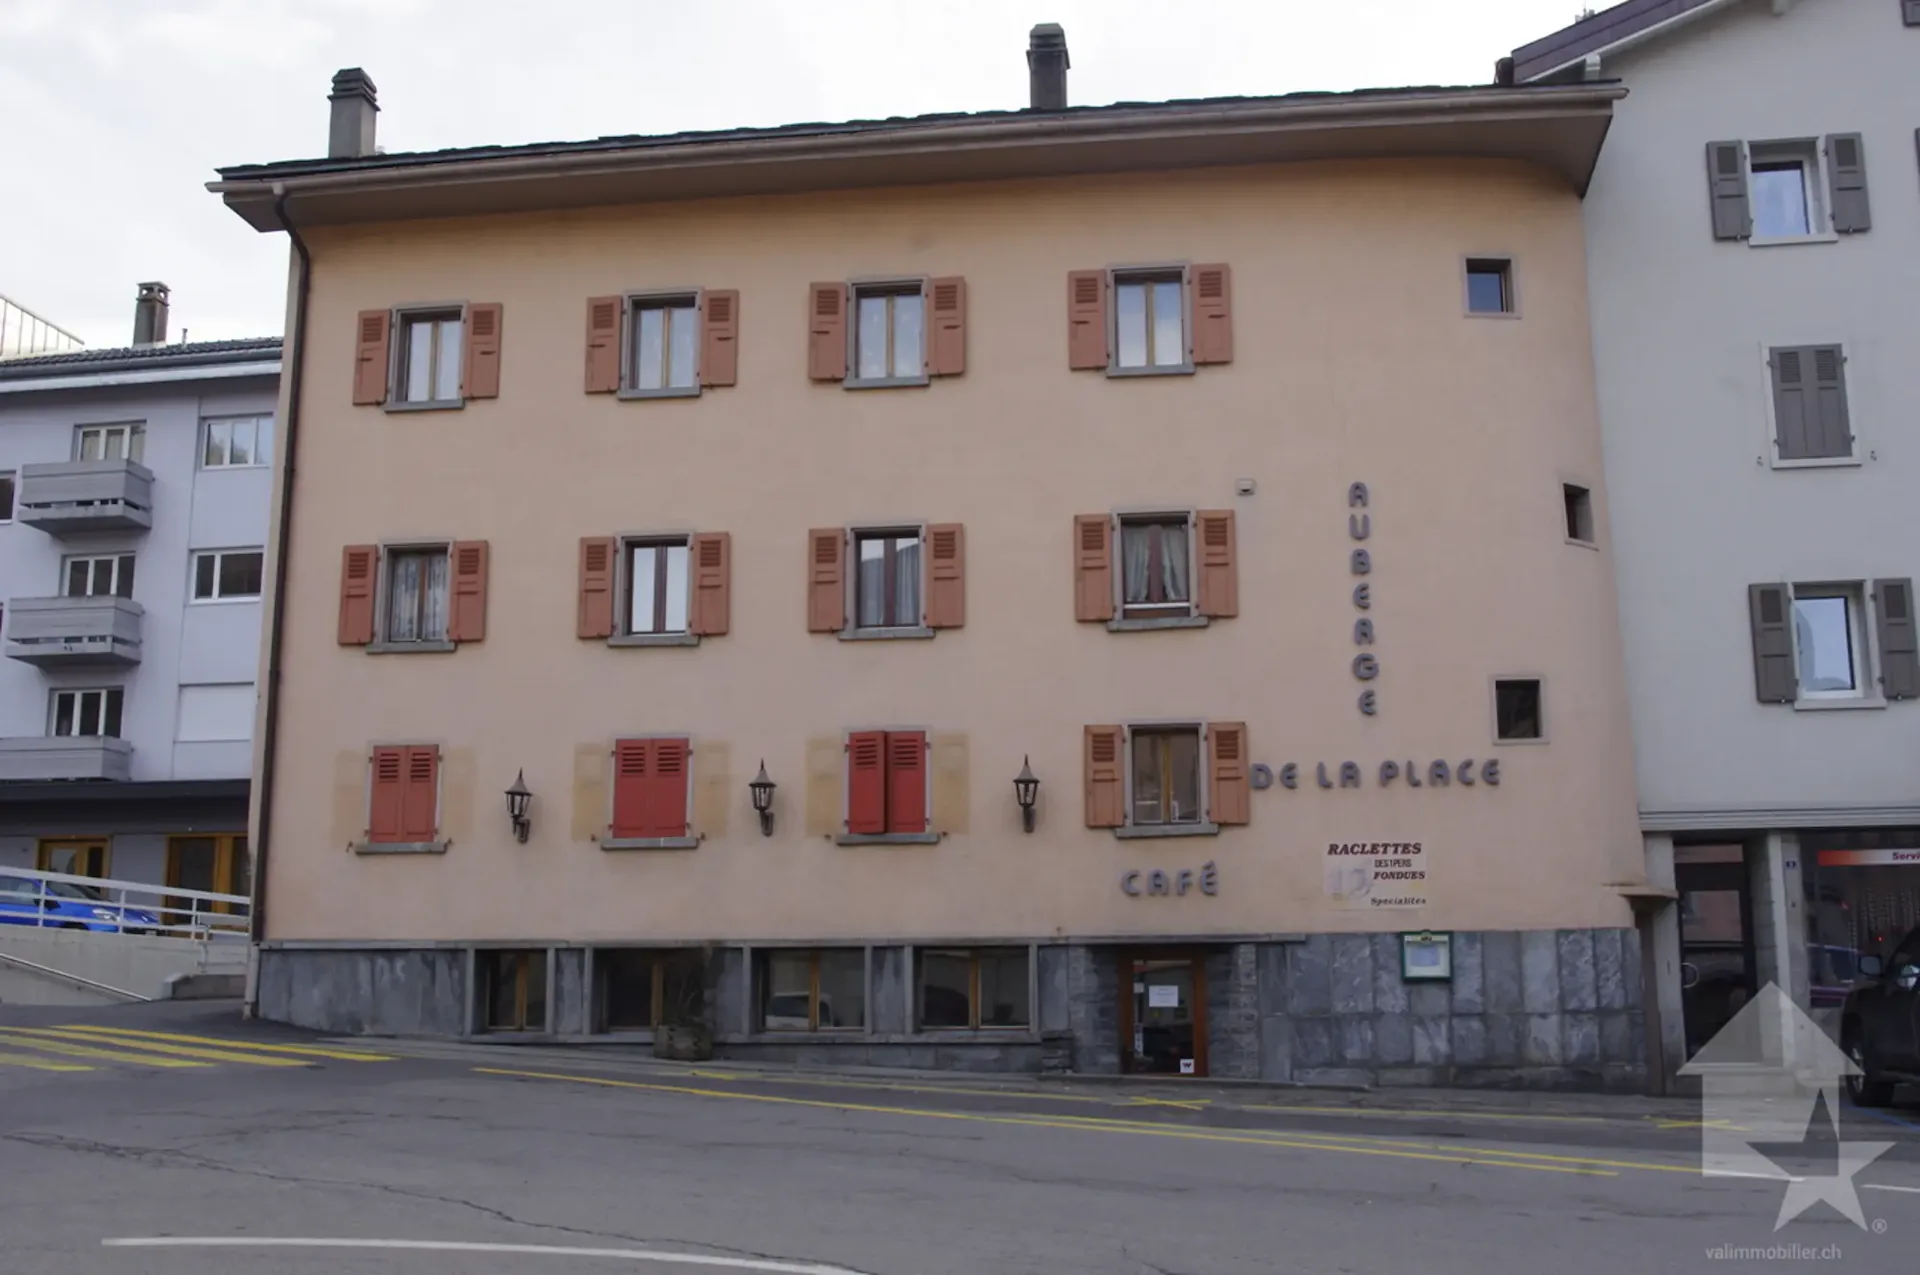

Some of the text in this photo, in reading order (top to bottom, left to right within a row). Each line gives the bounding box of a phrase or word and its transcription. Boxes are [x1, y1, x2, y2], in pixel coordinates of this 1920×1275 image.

[1349, 481, 1379, 716] AUBERGE
[1250, 758, 1500, 790] DE LA PLACE
[1327, 842, 1422, 855] RACLETTES
[1121, 859, 1219, 897] CAFÉ
[1373, 871, 1426, 880] FONDUES
